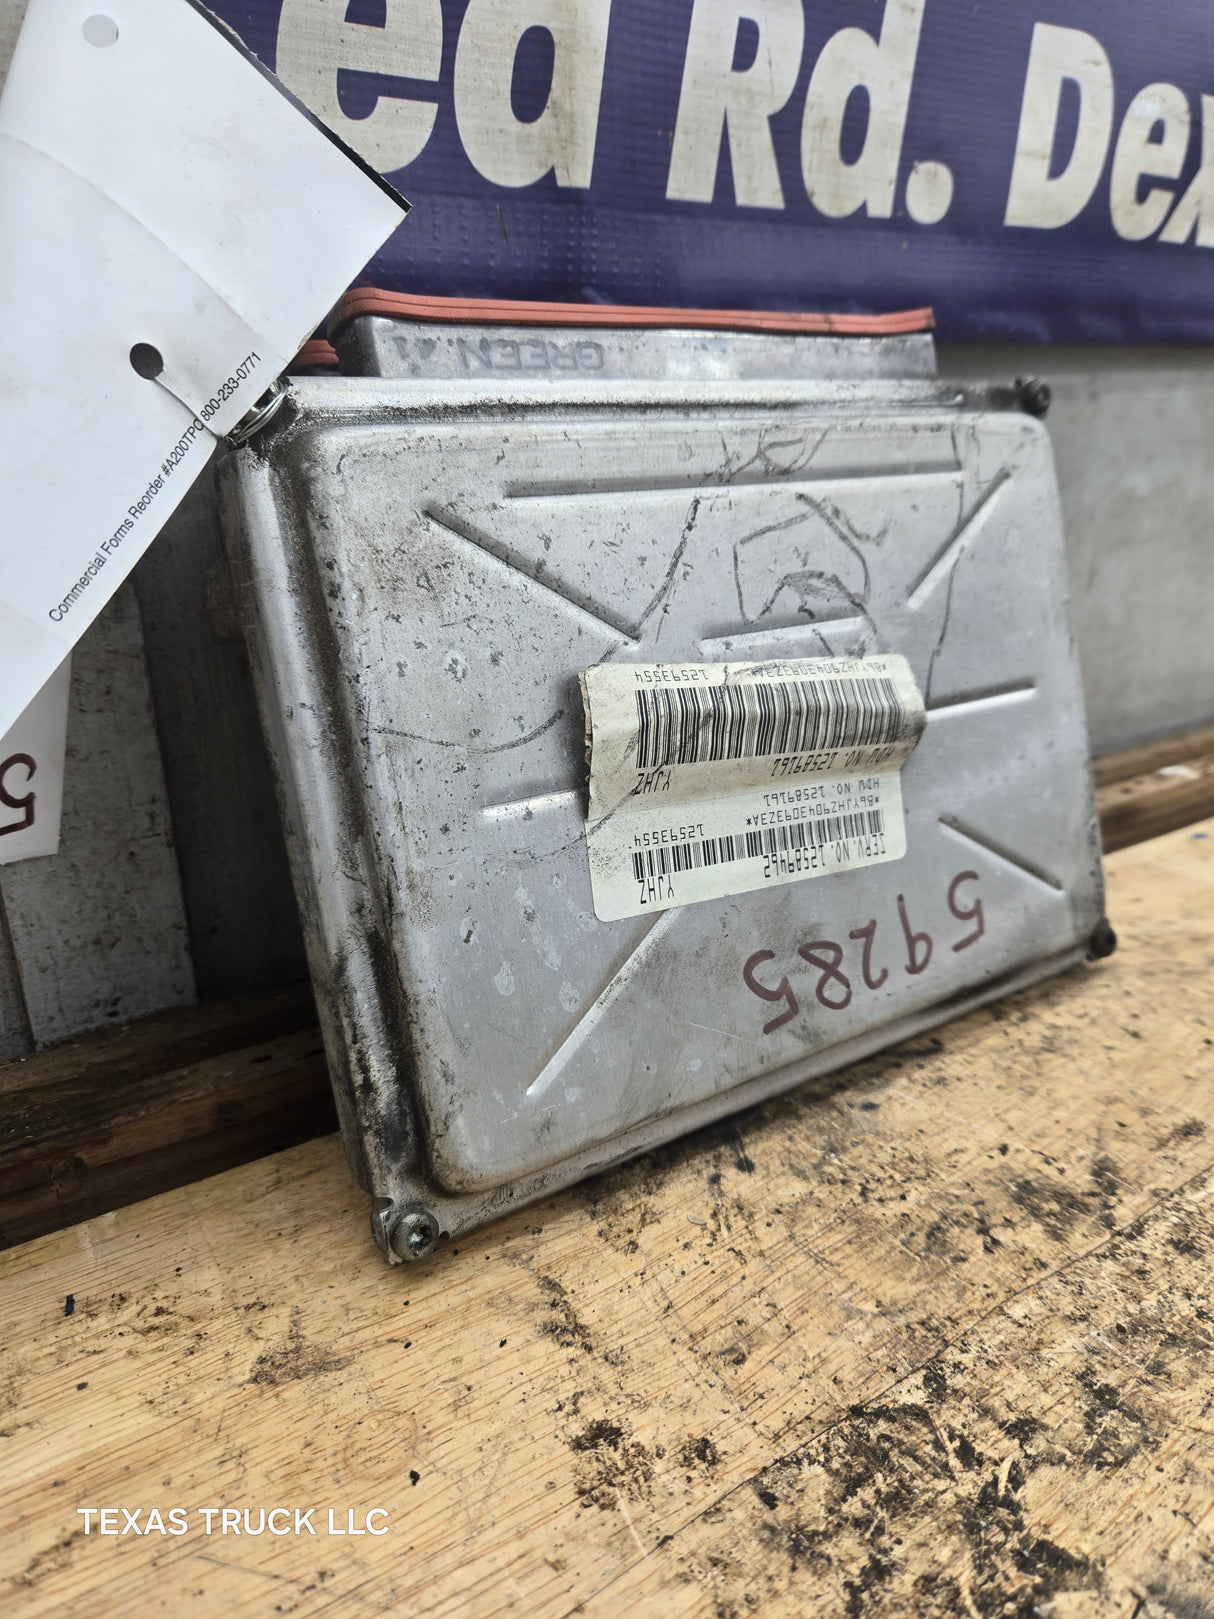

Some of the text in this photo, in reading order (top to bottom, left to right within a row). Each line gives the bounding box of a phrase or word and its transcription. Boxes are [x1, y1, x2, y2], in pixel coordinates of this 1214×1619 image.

[665, 0, 954, 225] Rd.
[48, 553, 108, 622] Commercial
[101, 517, 135, 557] Forms
[128, 474, 166, 522] Reorder
[200, 351, 262, 422] 800-233-0771
[634, 668, 709, 684] 12593554
[770, 752, 838, 777] 12589161
[845, 750, 865, 765] NO.
[634, 770, 672, 795] YJHZ
[764, 777, 880, 807] HDW NO. 12589161
[634, 823, 705, 846] 12593554
[764, 832, 886, 879] SERV. NO. 12589462
[637, 873, 675, 905] YJHZ
[743, 870, 985, 1035] 59285
